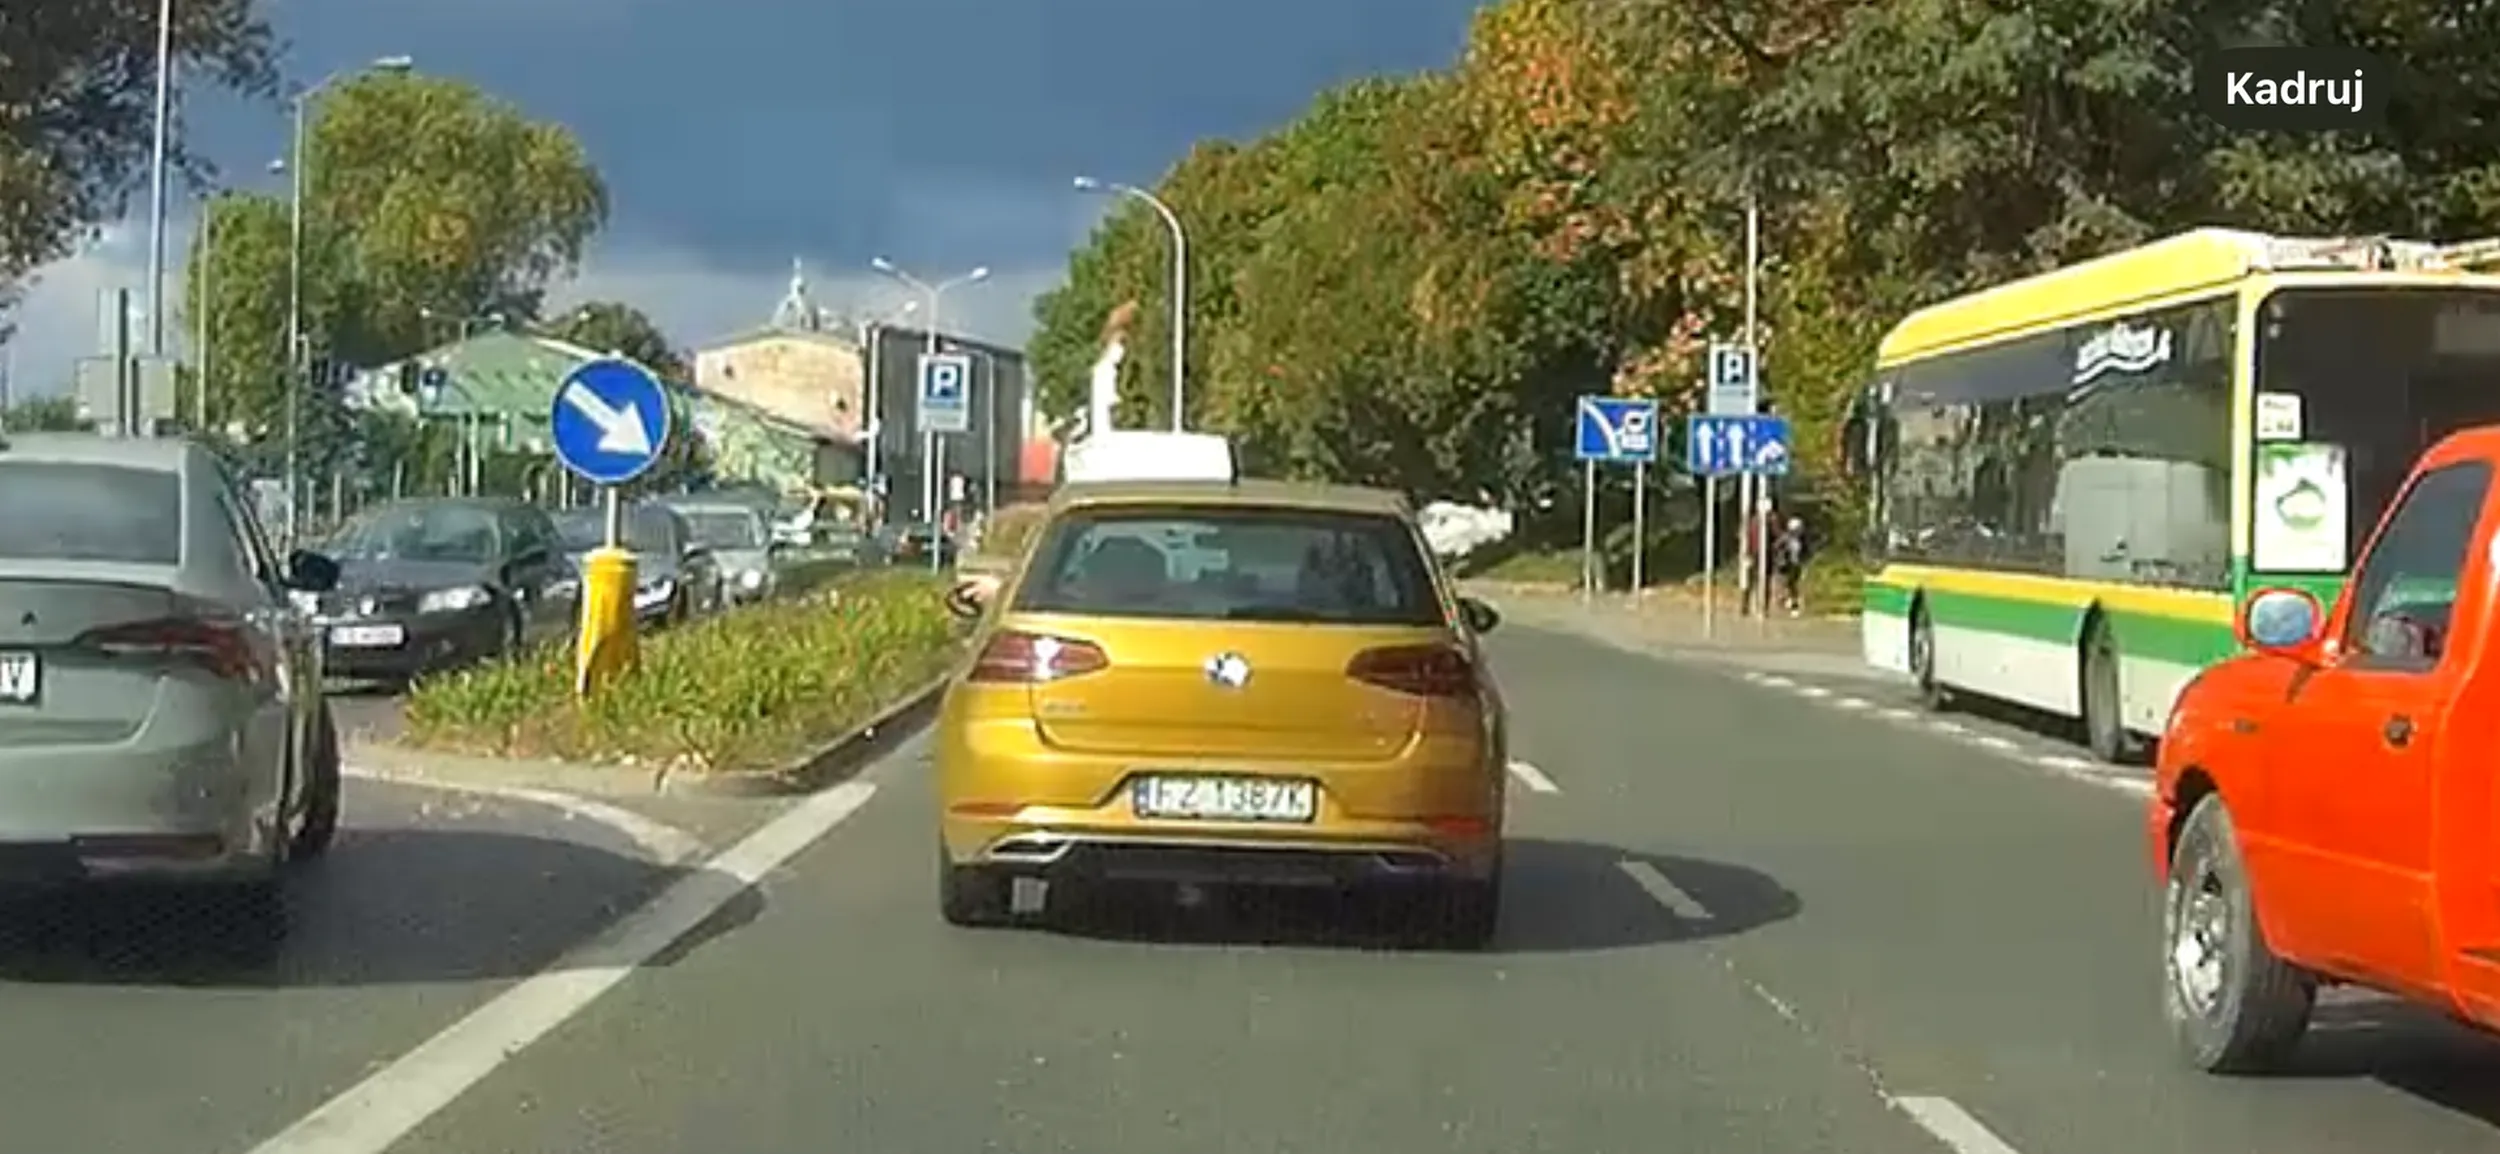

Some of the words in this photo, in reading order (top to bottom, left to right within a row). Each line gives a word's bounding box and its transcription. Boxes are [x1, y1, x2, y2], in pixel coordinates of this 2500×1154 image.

[933, 365, 958, 397] P
[1724, 352, 1744, 383] P
[0, 655, 28, 691] V
